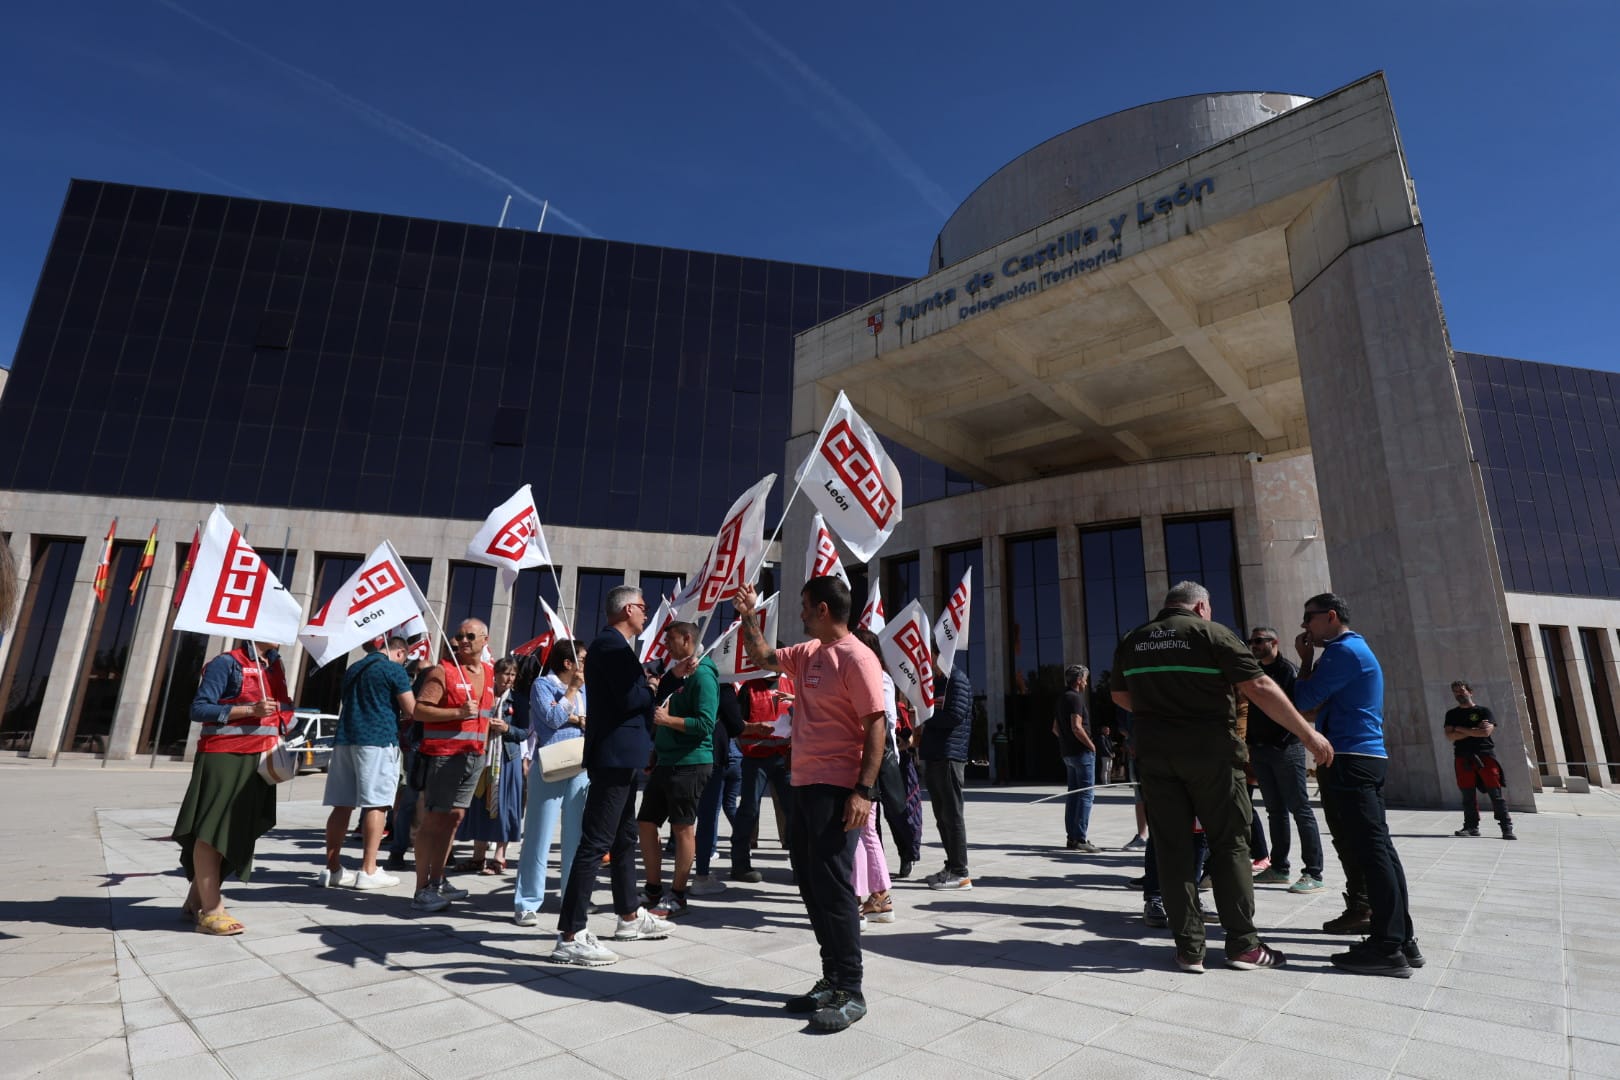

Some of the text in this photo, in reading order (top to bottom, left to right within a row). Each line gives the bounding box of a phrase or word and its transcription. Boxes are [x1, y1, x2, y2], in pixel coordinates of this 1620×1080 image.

[895, 288, 956, 326] Junta
[965, 272, 994, 294] de
[1002, 224, 1098, 277] Castilla
[1137, 177, 1215, 225] León
[960, 243, 1122, 319] Delegación Territorial
[826, 430, 890, 520] CCOO
[824, 480, 849, 512] León
[354, 608, 385, 628] León
[942, 618, 954, 641] León
[1150, 629, 1176, 638] AGENTE
[1135, 640, 1192, 652] MEDIOAMBIENTAL
[898, 661, 917, 685] León
